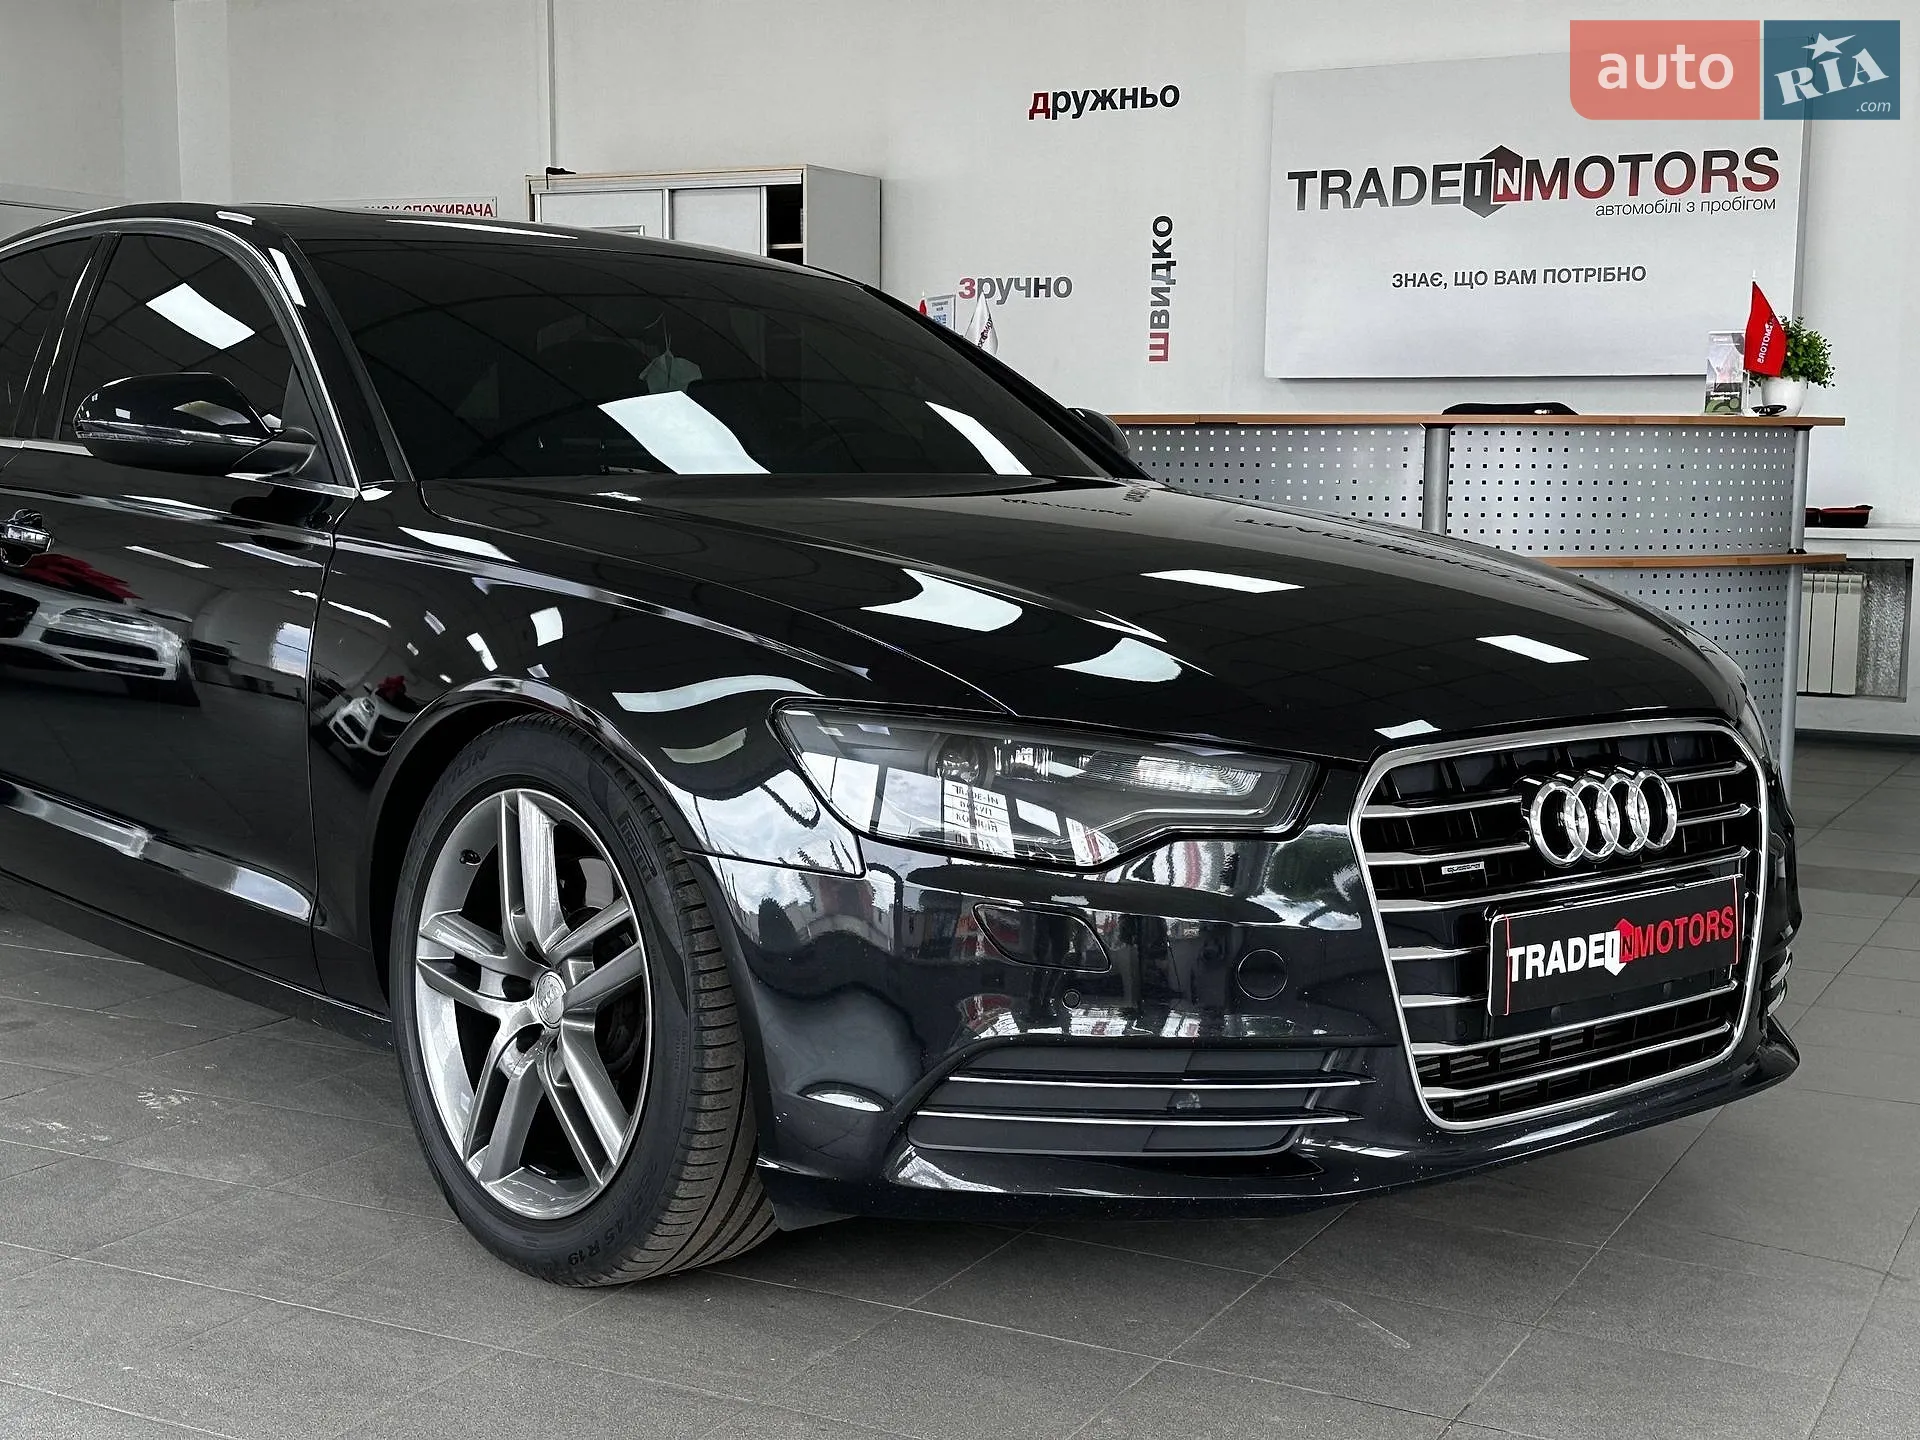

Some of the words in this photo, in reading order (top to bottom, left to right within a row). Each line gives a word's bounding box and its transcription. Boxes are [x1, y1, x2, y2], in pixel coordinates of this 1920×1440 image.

[1028, 84, 1180, 121] дружньо
[1595, 199, 1681, 216] автомобілі
[1686, 201, 1695, 213] з
[1700, 196, 1776, 215] пробігом
[958, 276, 1073, 305] зручно
[1149, 216, 1176, 361] швидко
[1392, 272, 1448, 290] ЗНАЄ,
[1454, 270, 1488, 289] ЩО
[1494, 269, 1537, 286] ВАМ
[1543, 265, 1647, 284] ПОТРІБНО
